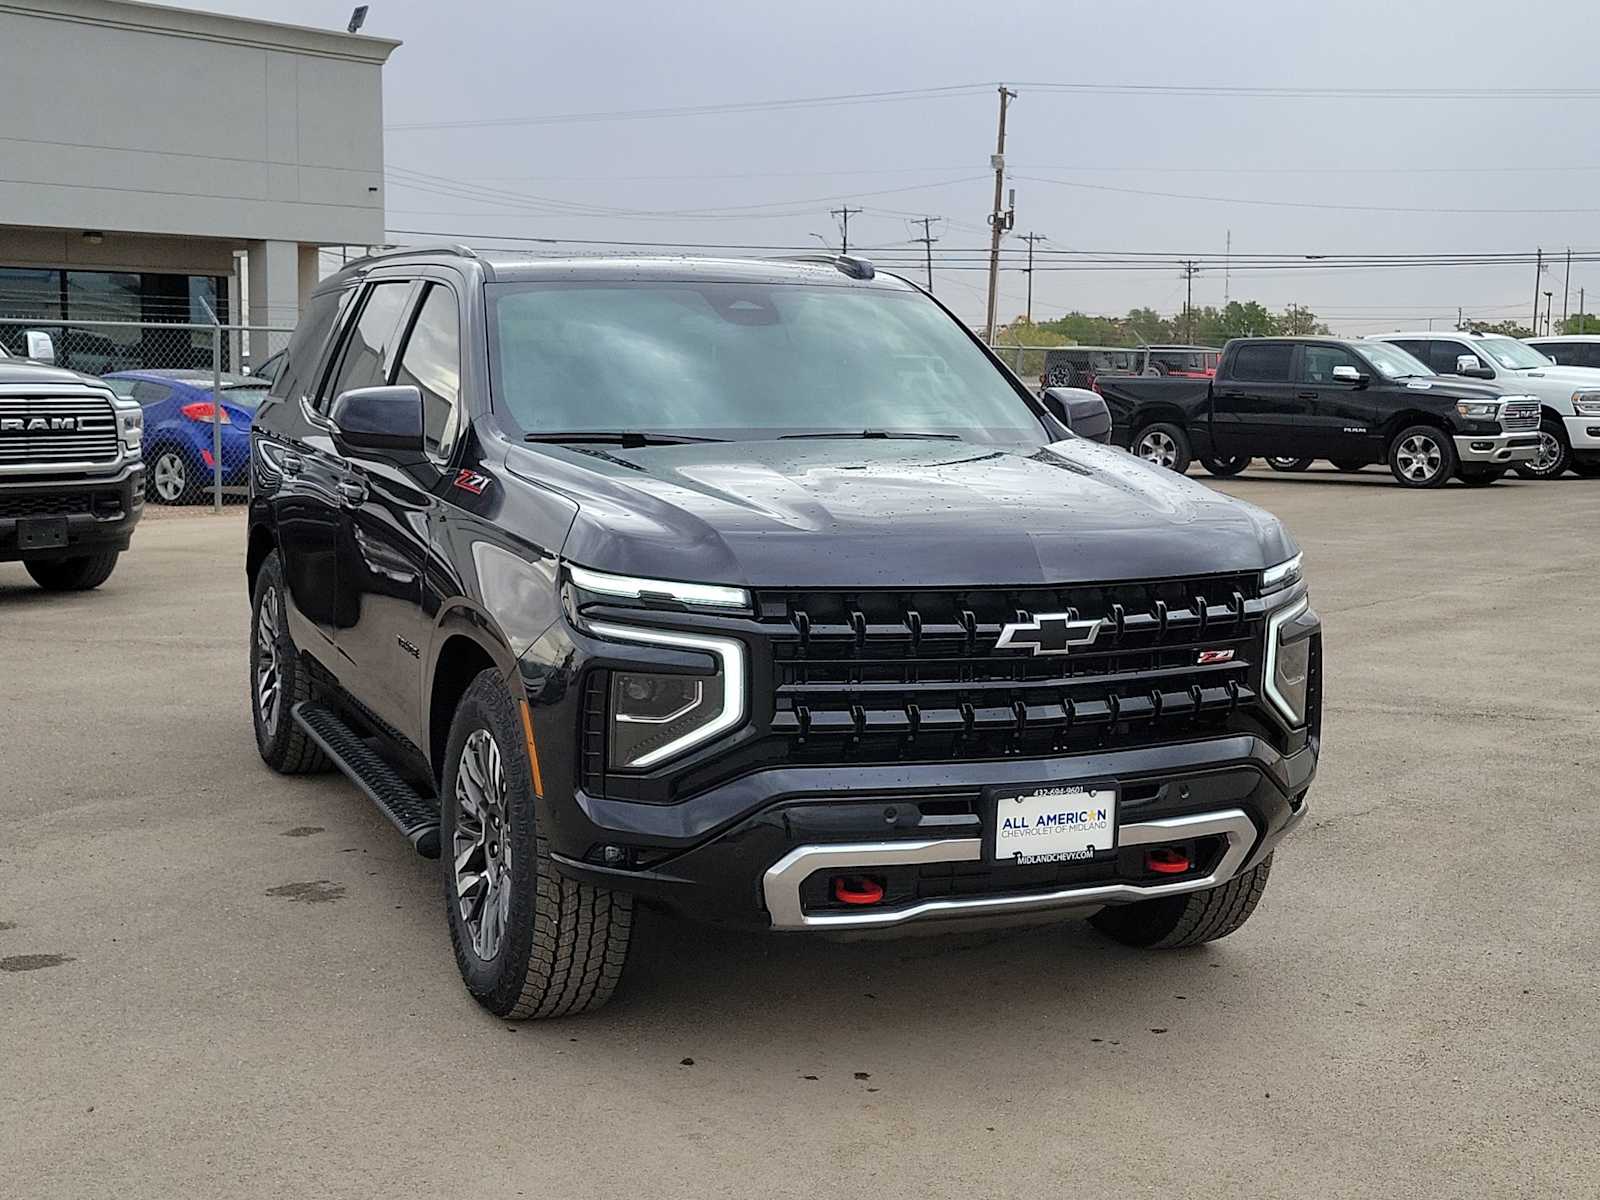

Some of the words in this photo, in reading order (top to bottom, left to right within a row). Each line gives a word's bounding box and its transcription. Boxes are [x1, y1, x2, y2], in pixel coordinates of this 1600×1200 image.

[1, 418, 75, 430] RAM
[454, 469, 492, 495] Z71
[1197, 649, 1235, 664] Z71
[1001, 826, 1053, 839] CHEVROLET
[1054, 825, 1066, 834] OF
[1068, 821, 1107, 833] MIDLAND
[1002, 816, 1029, 830] ALL
[1017, 850, 1094, 865] MIDLANDCHEVY.COM
